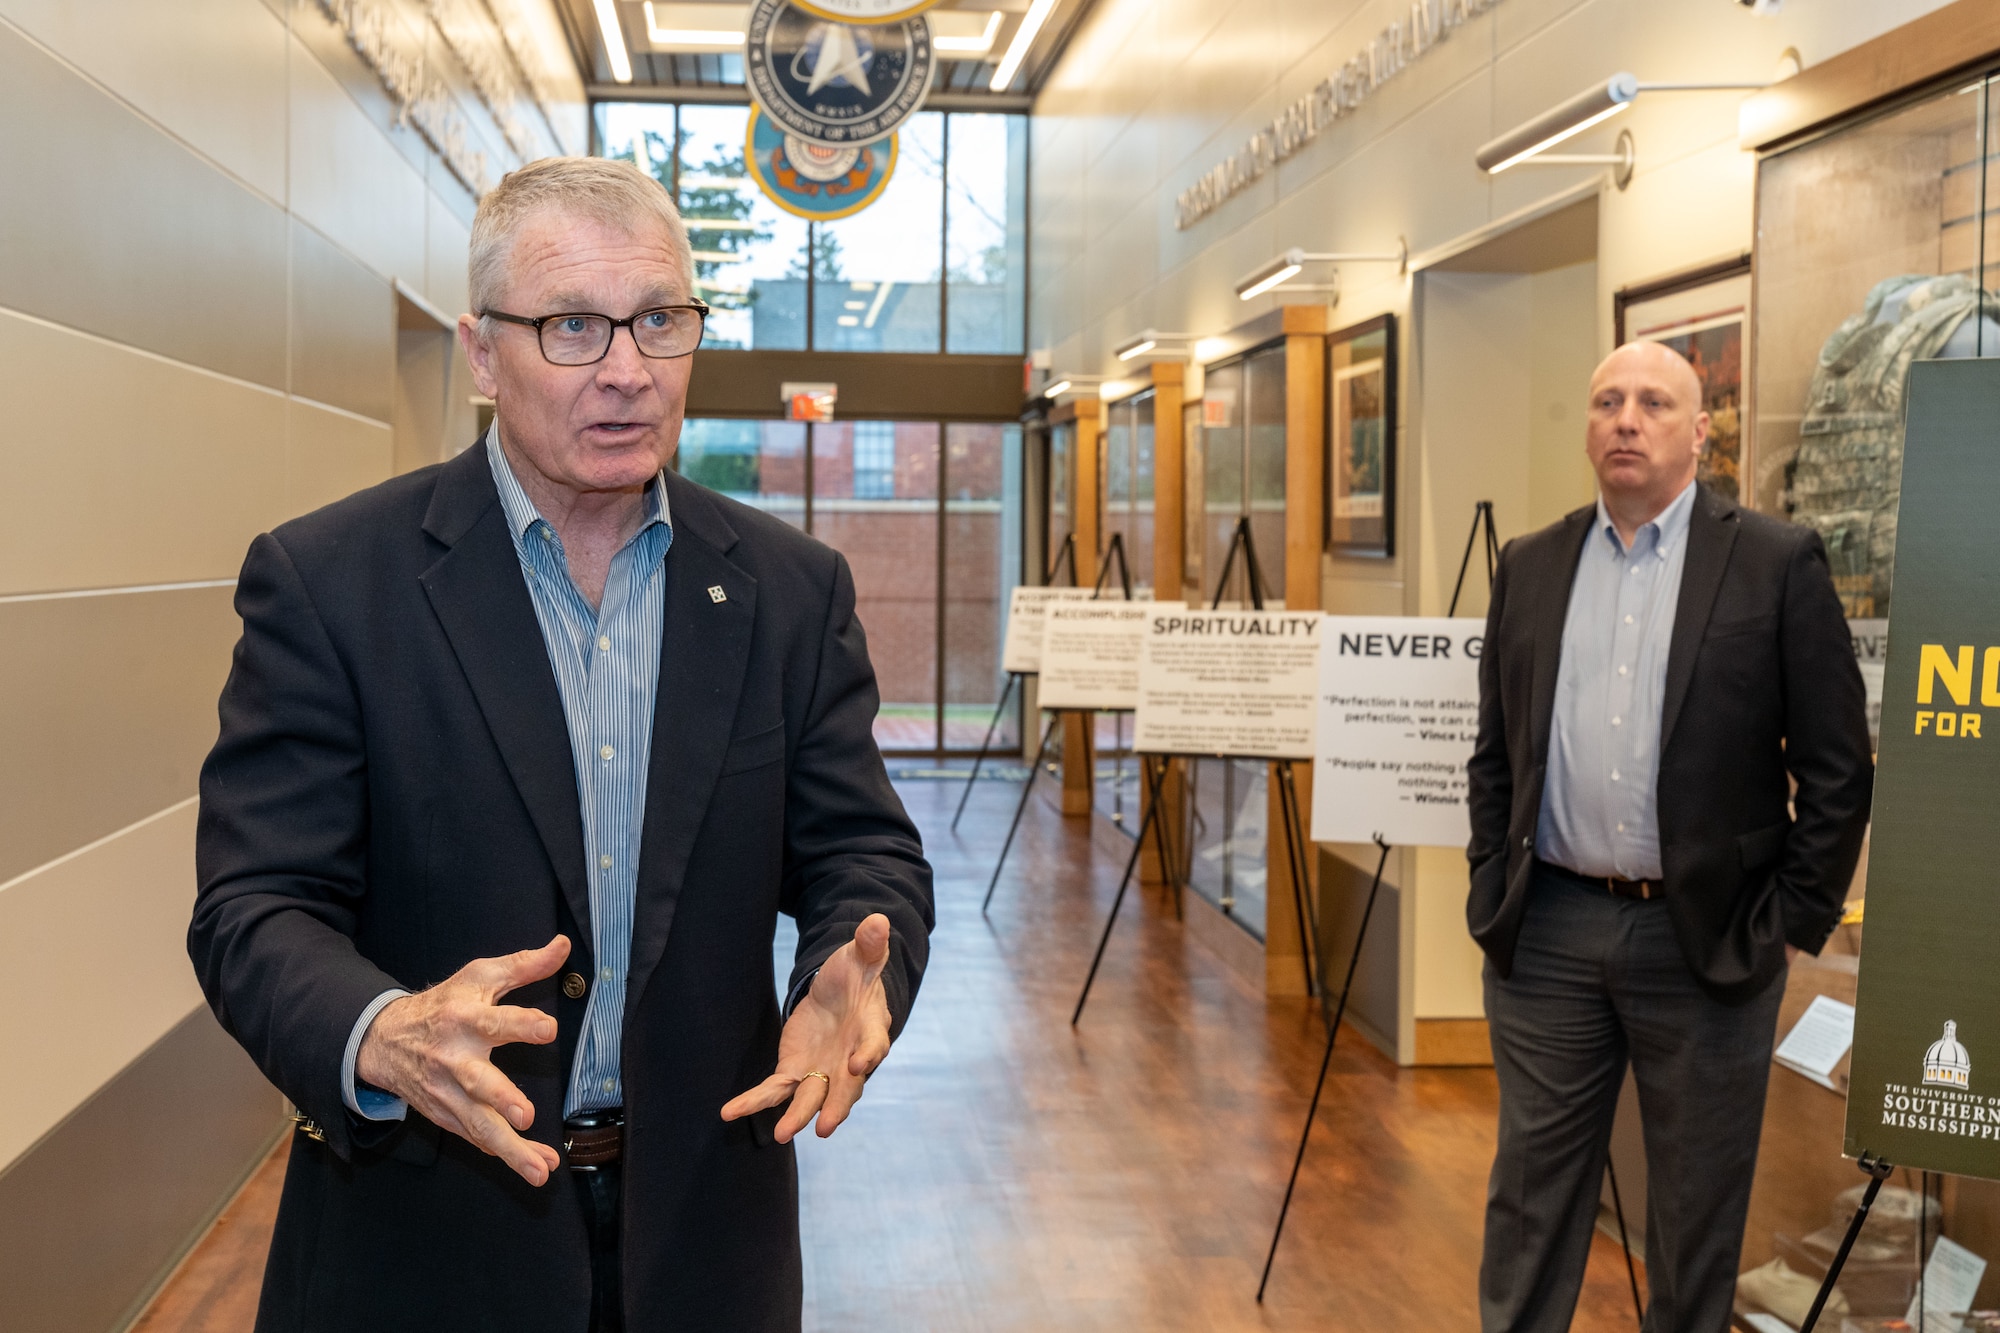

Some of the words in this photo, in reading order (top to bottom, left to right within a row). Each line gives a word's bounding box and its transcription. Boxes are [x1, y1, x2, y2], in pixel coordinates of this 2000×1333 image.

[1153, 616, 1318, 637] SPIRITUALITY
[1339, 633, 1452, 660] NEVER
[1400, 697, 1410, 709] is
[1413, 699, 1435, 710] not
[1344, 712, 1415, 726] perfection,
[1418, 716, 1437, 726] we
[1440, 716, 1464, 727] can
[1915, 710, 1982, 738] FOR
[1419, 729, 1456, 742] Vince
[1380, 760, 1402, 773] say
[1405, 760, 1456, 774] nothing
[1398, 776, 1448, 790] nothing
[1414, 792, 1460, 805] Winnie
[1885, 1083, 1908, 1094] THE
[1912, 1087, 1984, 1105] UNIVERSITY
[1883, 1093, 2000, 1124] SOUTHERN
[1881, 1110, 2000, 1141] MISSISSIPPI
